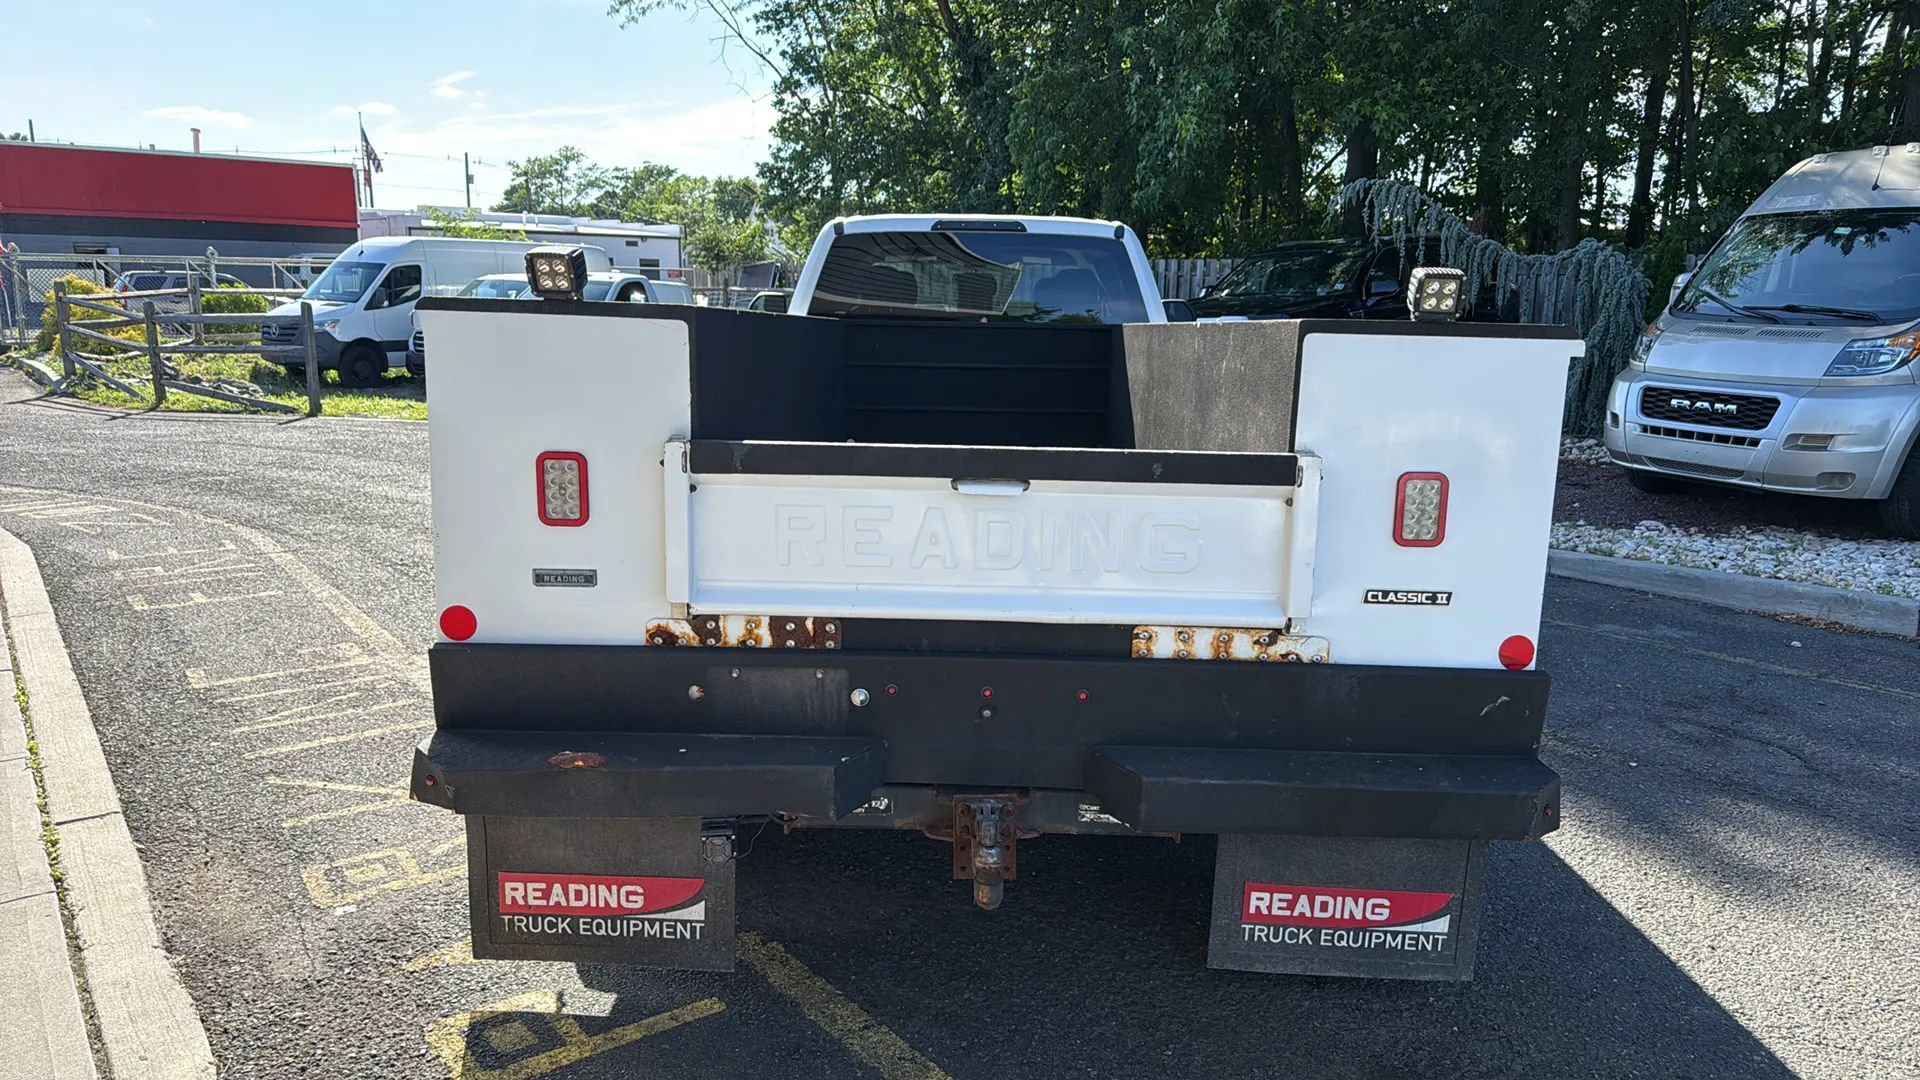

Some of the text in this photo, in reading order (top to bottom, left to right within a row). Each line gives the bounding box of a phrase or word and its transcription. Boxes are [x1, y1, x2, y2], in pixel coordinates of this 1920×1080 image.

[1670, 398, 1737, 415] RAM
[775, 503, 1203, 575] READING
[543, 575, 585, 583] READING
[1367, 591, 1449, 604] CLASSIC II
[504, 881, 645, 909] READING
[1249, 891, 1391, 921] READING
[501, 915, 705, 940] TRUCK EQUIPMENT
[1241, 924, 1448, 951] TRUCK EQUIPMENT
